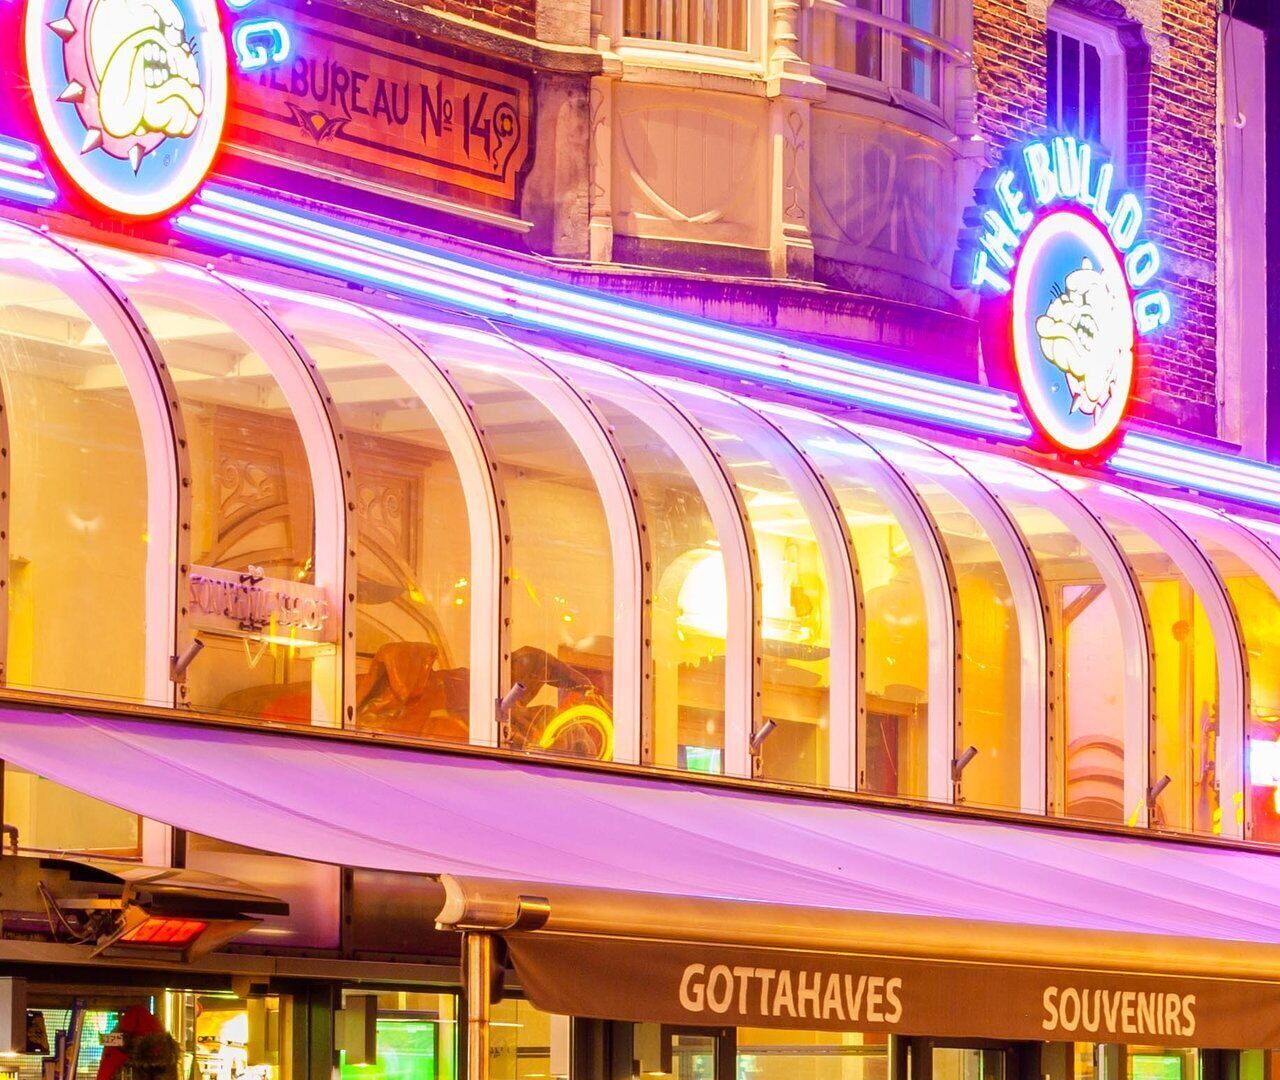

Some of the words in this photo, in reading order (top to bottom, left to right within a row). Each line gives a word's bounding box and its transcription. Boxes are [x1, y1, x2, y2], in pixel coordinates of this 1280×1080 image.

[971, 170, 1034, 292] THE
[1023, 135, 1171, 336] BULLDOG
[679, 963, 903, 1024] GOTTAHAVES
[1042, 986, 1196, 1037] SOUVENIRS
